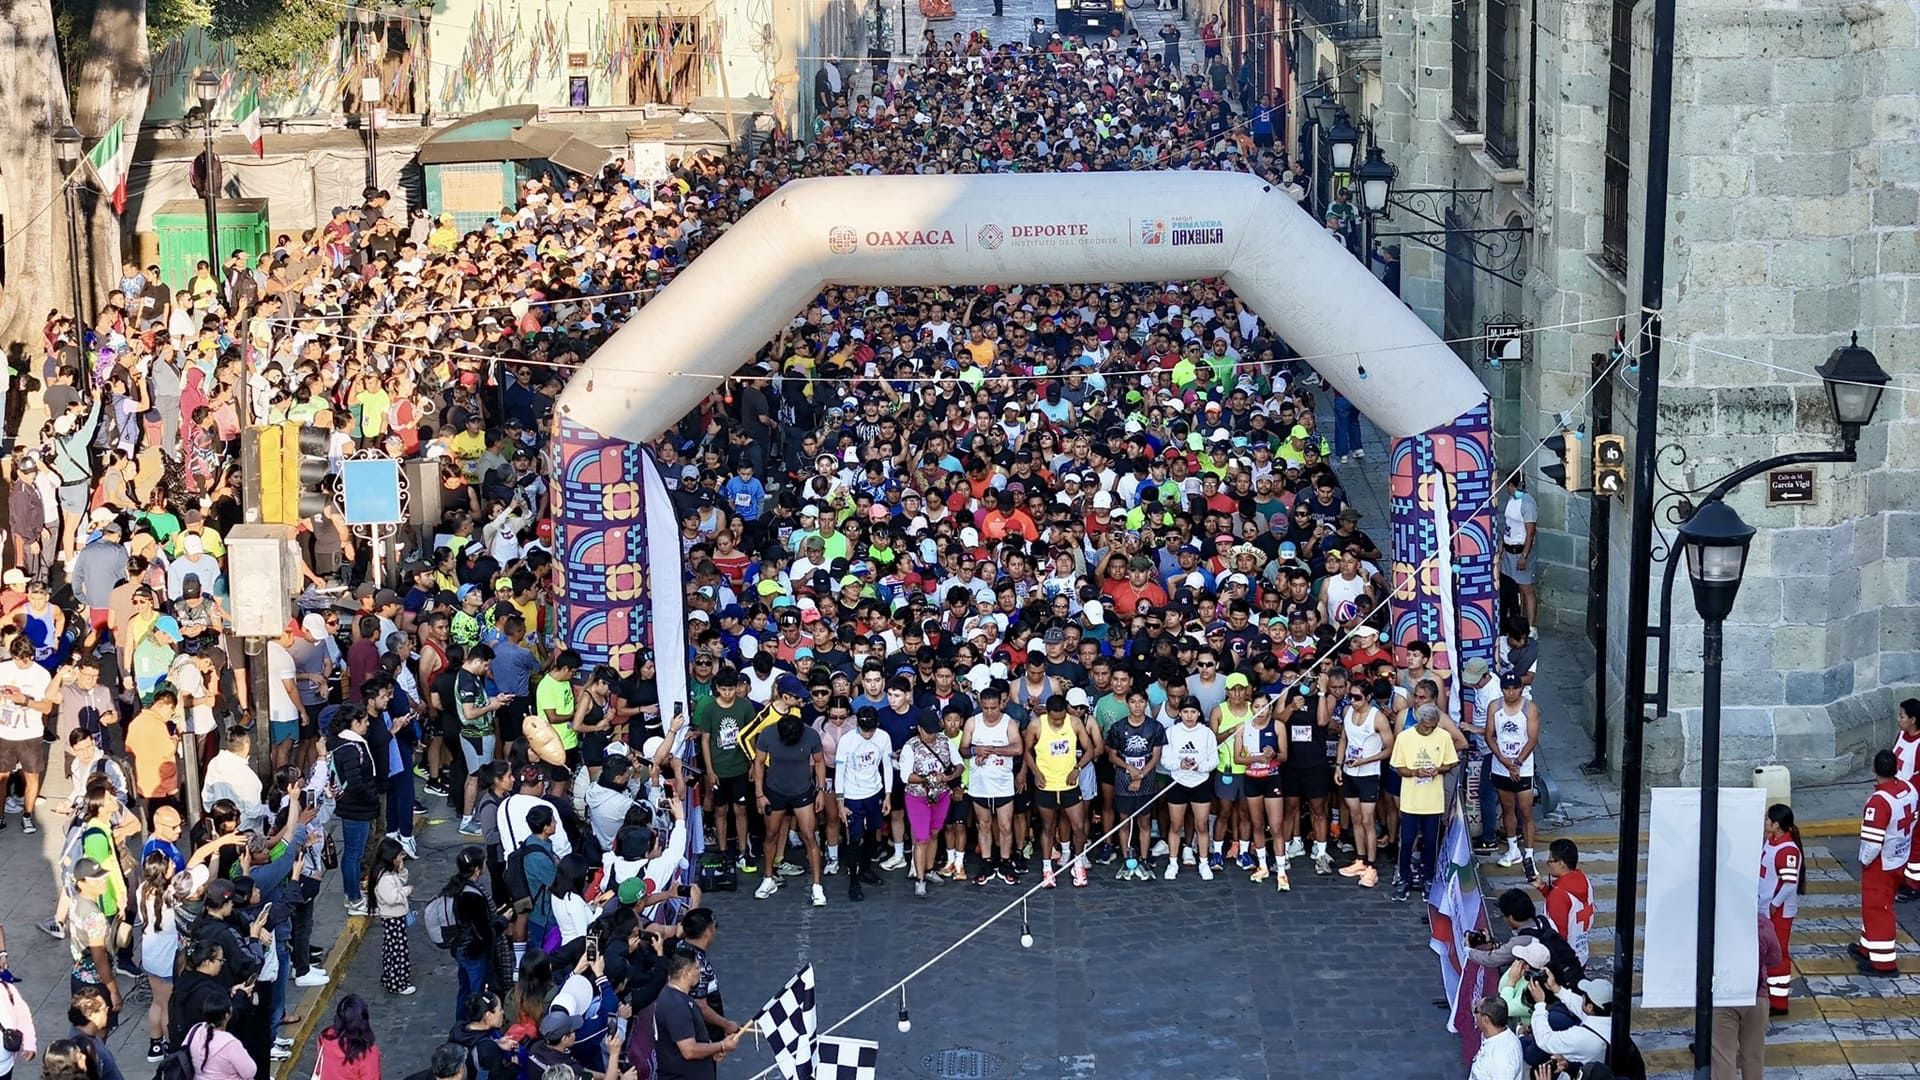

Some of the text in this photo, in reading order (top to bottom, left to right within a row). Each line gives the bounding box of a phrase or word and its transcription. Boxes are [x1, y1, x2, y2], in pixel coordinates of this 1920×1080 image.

[1172, 220, 1222, 228] PRIMAVERA
[1011, 223, 1088, 237] DEPORTE
[866, 230, 955, 246] OAXACA
[1012, 239, 1056, 247] INSTITUTO
[1772, 480, 1810, 489] García Vigil
